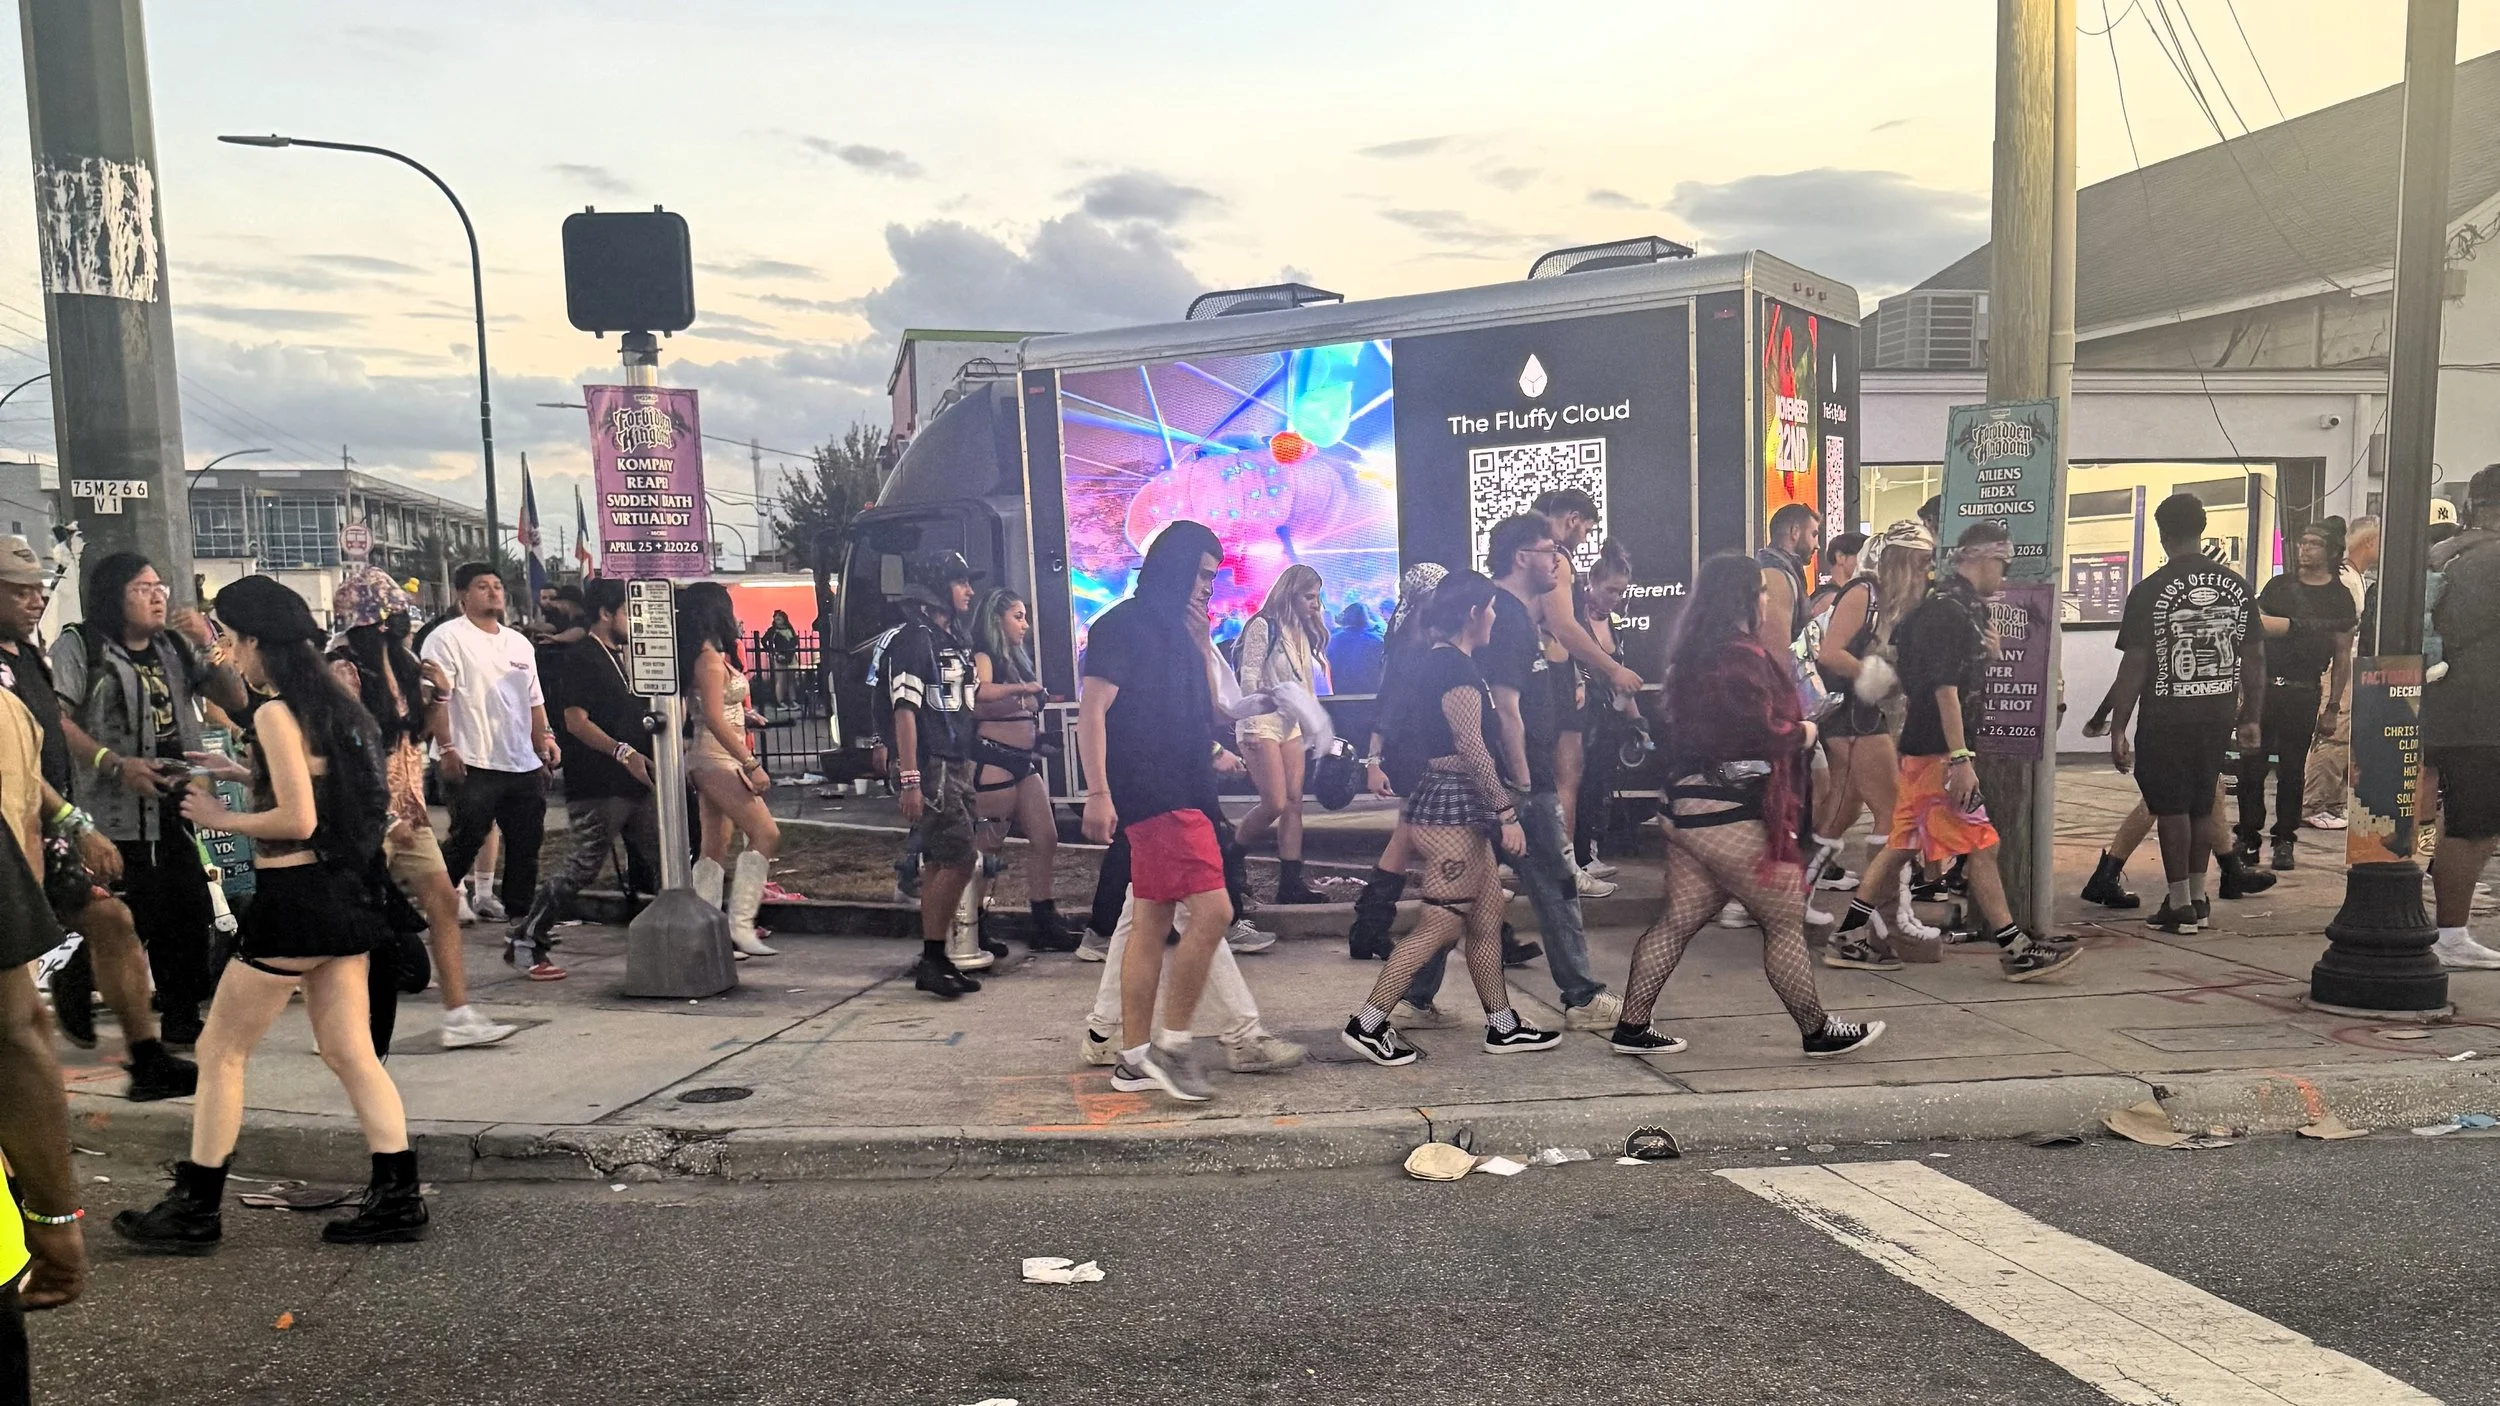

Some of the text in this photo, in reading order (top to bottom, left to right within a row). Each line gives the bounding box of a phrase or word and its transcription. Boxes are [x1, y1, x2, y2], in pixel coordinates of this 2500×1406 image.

[1447, 398, 1630, 435] The Fluffy Cloud
[1972, 420, 2033, 447] Forbidden
[1775, 421, 1809, 473] 22ND
[1974, 439, 2030, 466] Kingdom
[1977, 467, 2022, 482] ATLIENS
[1980, 485, 2016, 499] HEDEX
[1959, 501, 2035, 516] SUBTRONICS
[612, 512, 666, 525] VIRTUAL
[609, 541, 636, 553] APRIL
[638, 542, 653, 552] 25
[2017, 545, 2043, 556] 2026
[1993, 683, 2038, 695] DEATH
[2173, 680, 2233, 696] SPONSOR
[2000, 700, 2033, 711] RIOT
[2008, 726, 2037, 737] 2026
[2384, 725, 2415, 737] CHRIS
